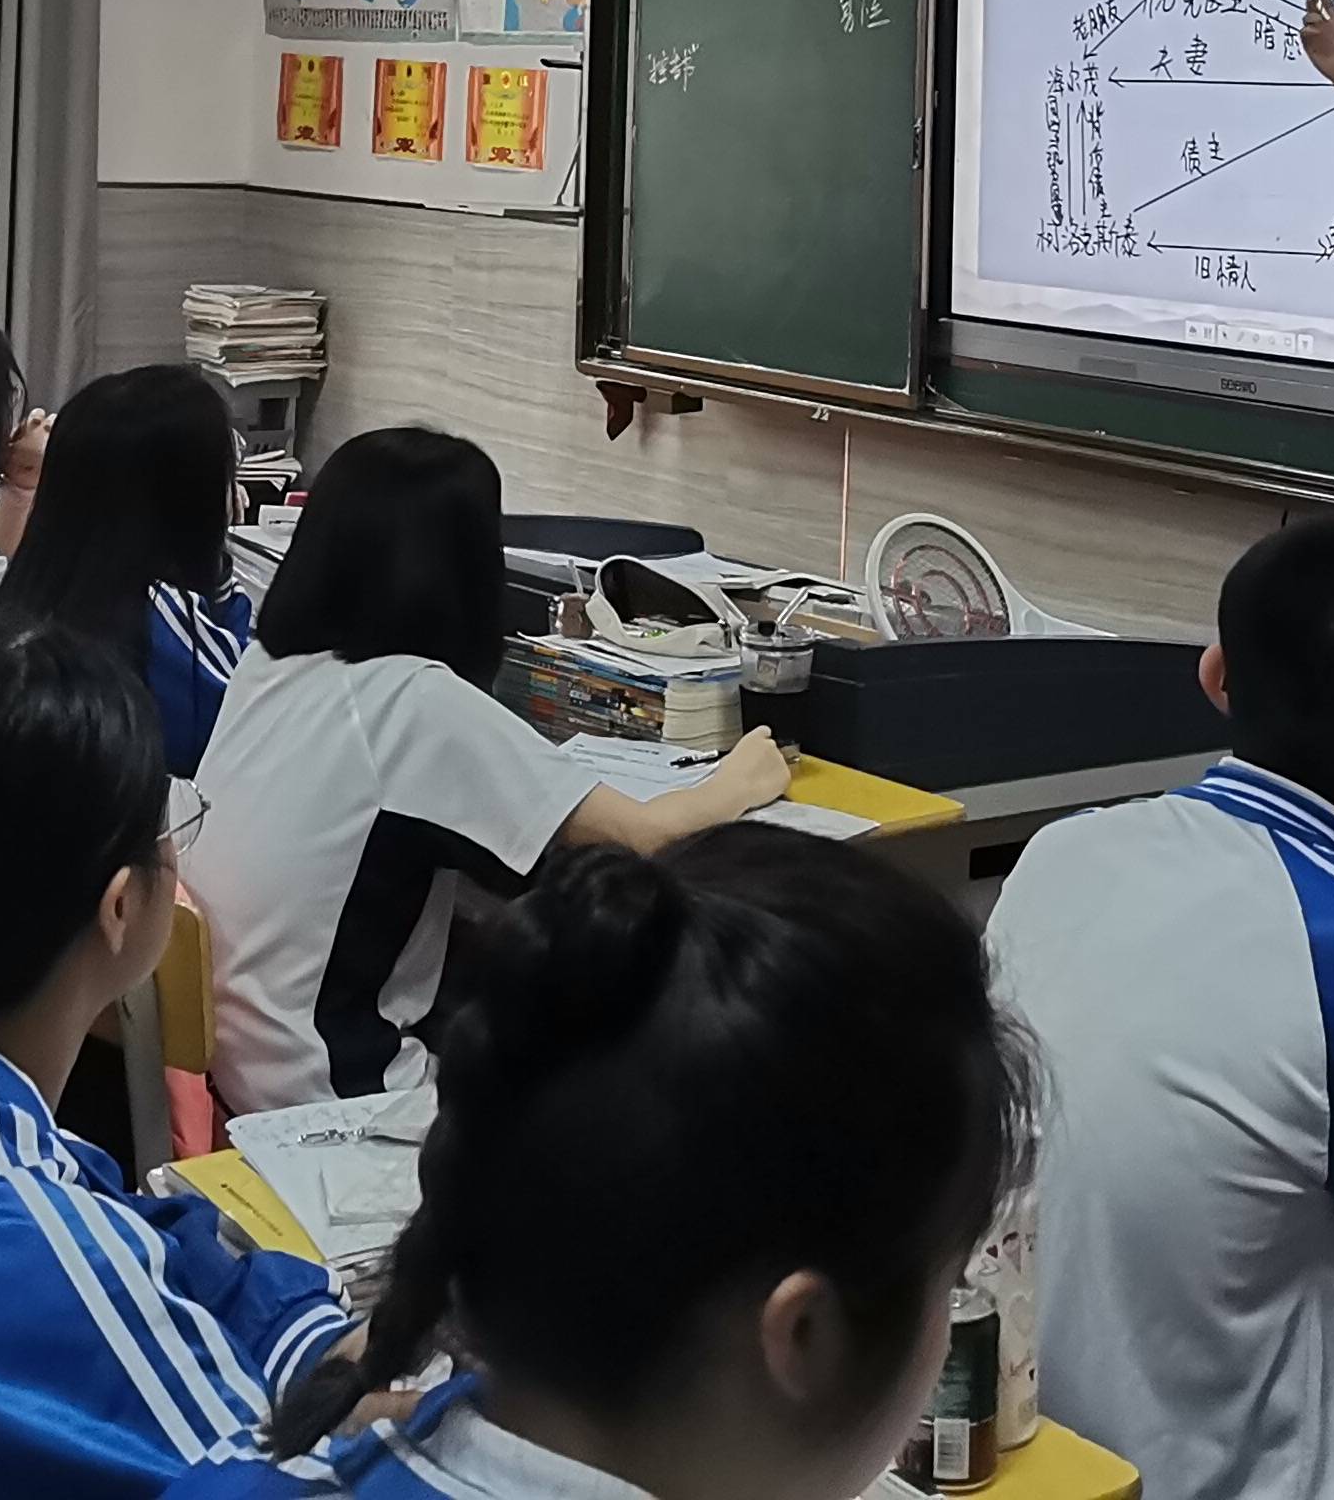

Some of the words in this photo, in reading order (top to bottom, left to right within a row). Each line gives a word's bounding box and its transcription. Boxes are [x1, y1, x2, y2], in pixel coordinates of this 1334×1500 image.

[1046, 60, 1099, 97] 海尔茂
[1149, 33, 1208, 80] 夫妻
[1181, 132, 1225, 177] 债主
[1036, 212, 1142, 259] 柯洛克斯泰
[1194, 255, 1257, 293] 旧情人
